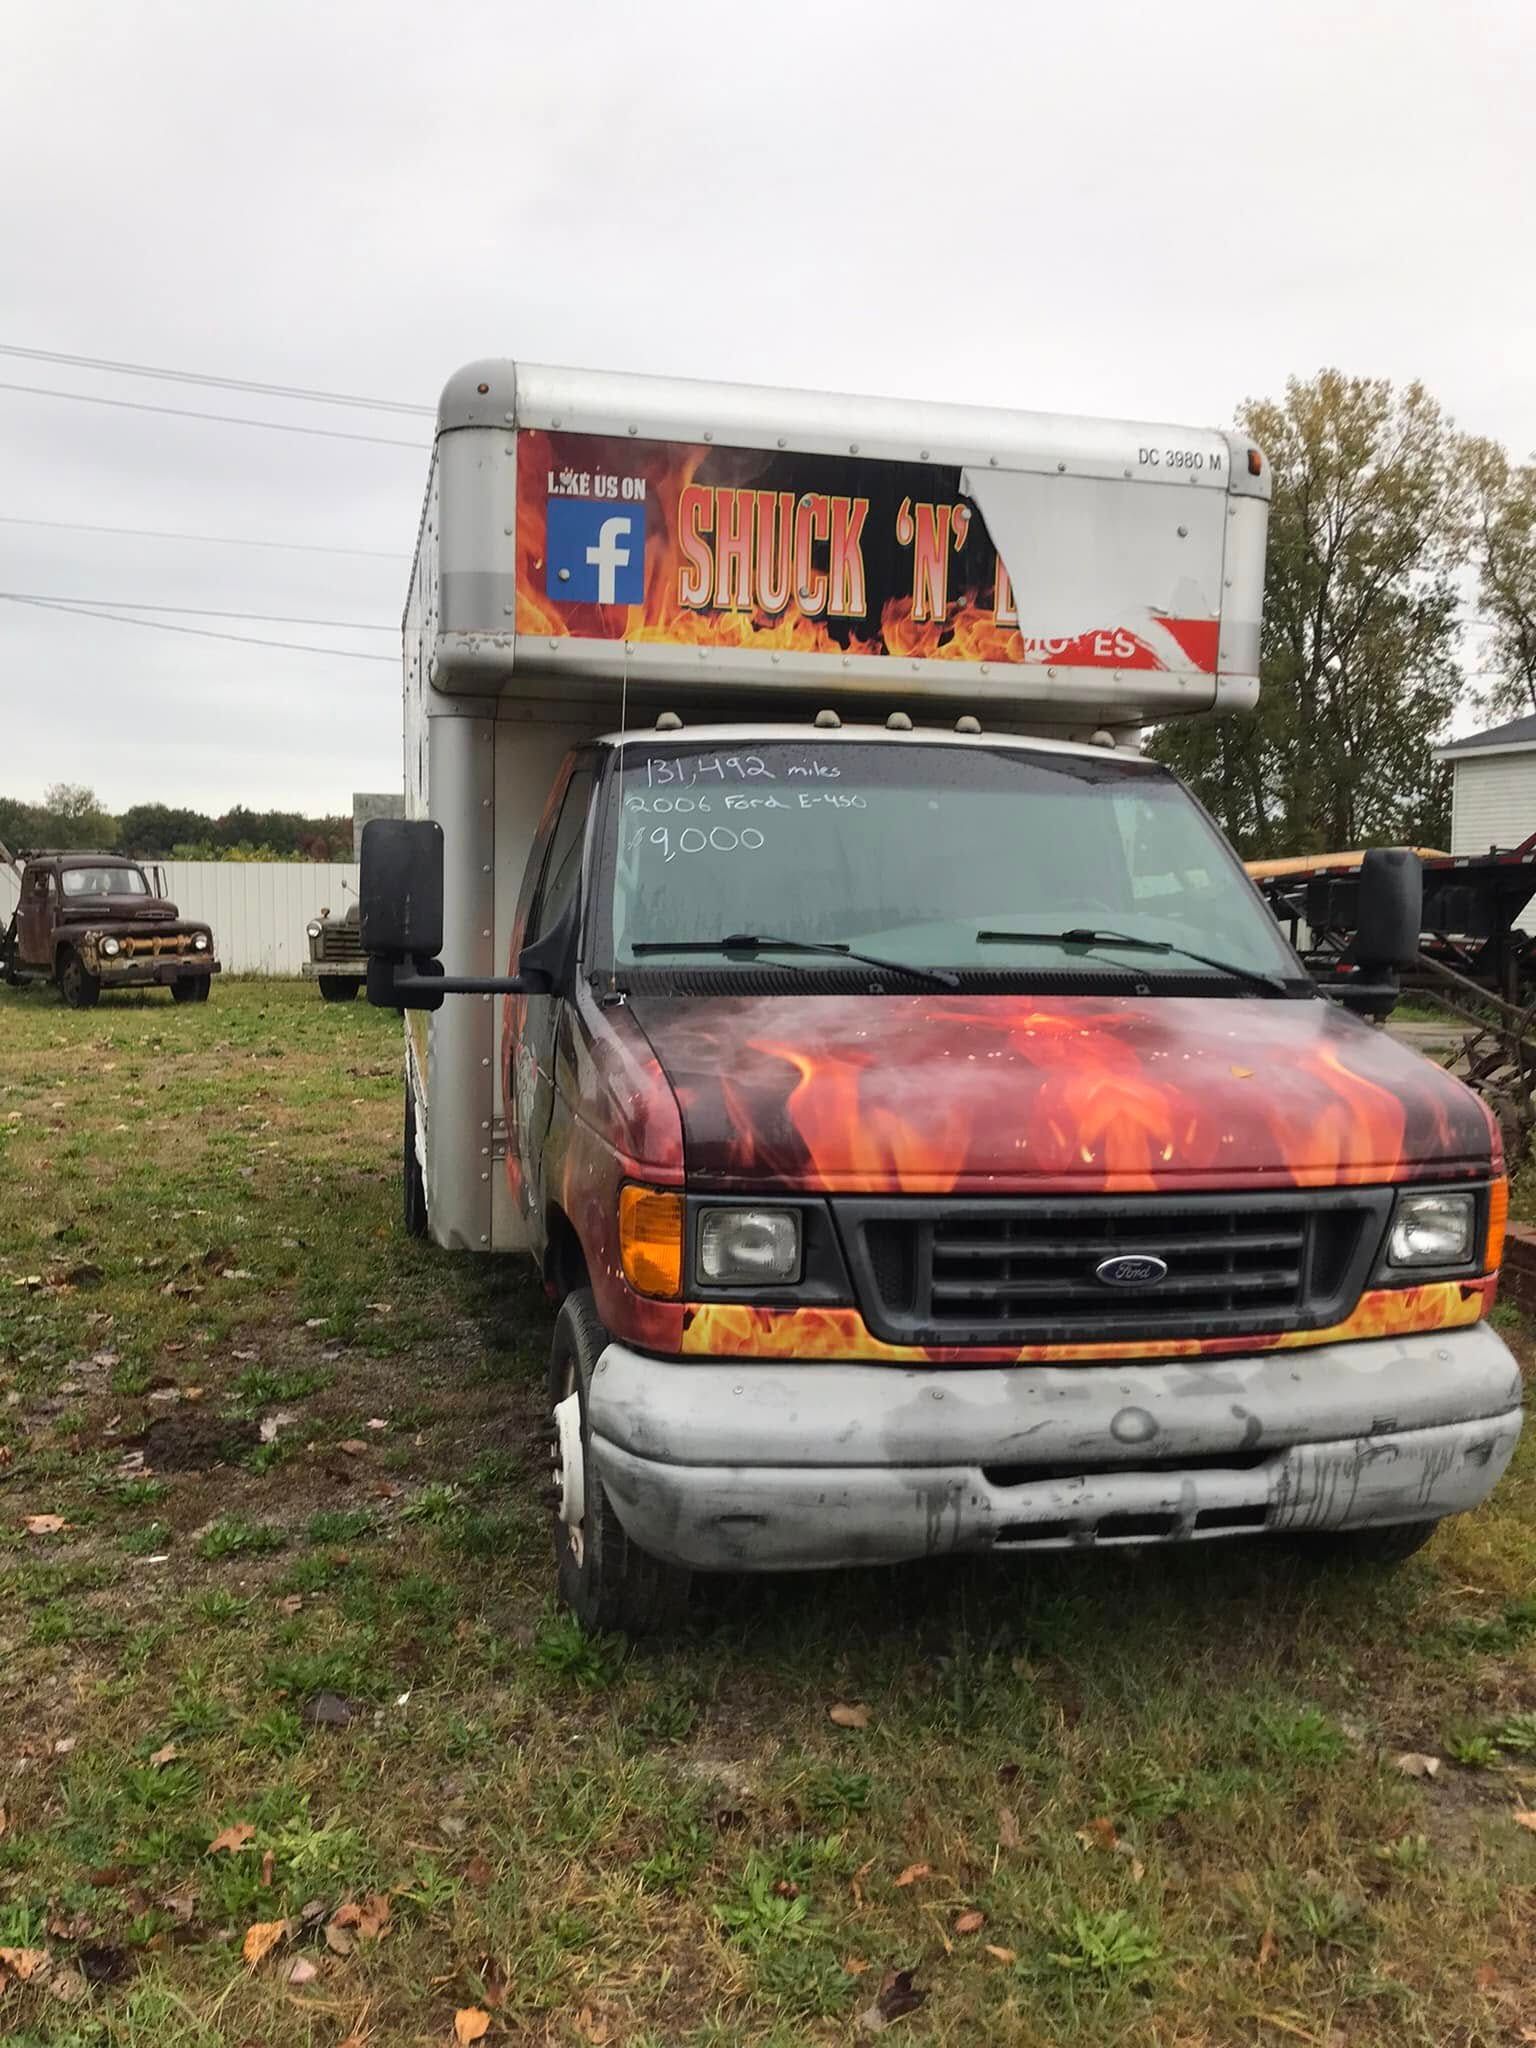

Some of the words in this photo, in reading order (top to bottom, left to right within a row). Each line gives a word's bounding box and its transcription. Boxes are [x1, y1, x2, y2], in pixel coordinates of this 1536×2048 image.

[1138, 447, 1160, 466] DC
[1165, 450, 1204, 470] 3980
[1209, 453, 1222, 471] M
[547, 467, 590, 497] LIKE
[594, 474, 618, 498] US
[621, 477, 646, 501] ON
[678, 484, 869, 617] SHUCK
[647, 757, 776, 789] 131,492
[788, 759, 841, 778] miles
[625, 794, 712, 813] 2006
[724, 795, 793, 809] Ford
[799, 794, 868, 809] E-450
[1115, 1262, 1152, 1279] Ford
